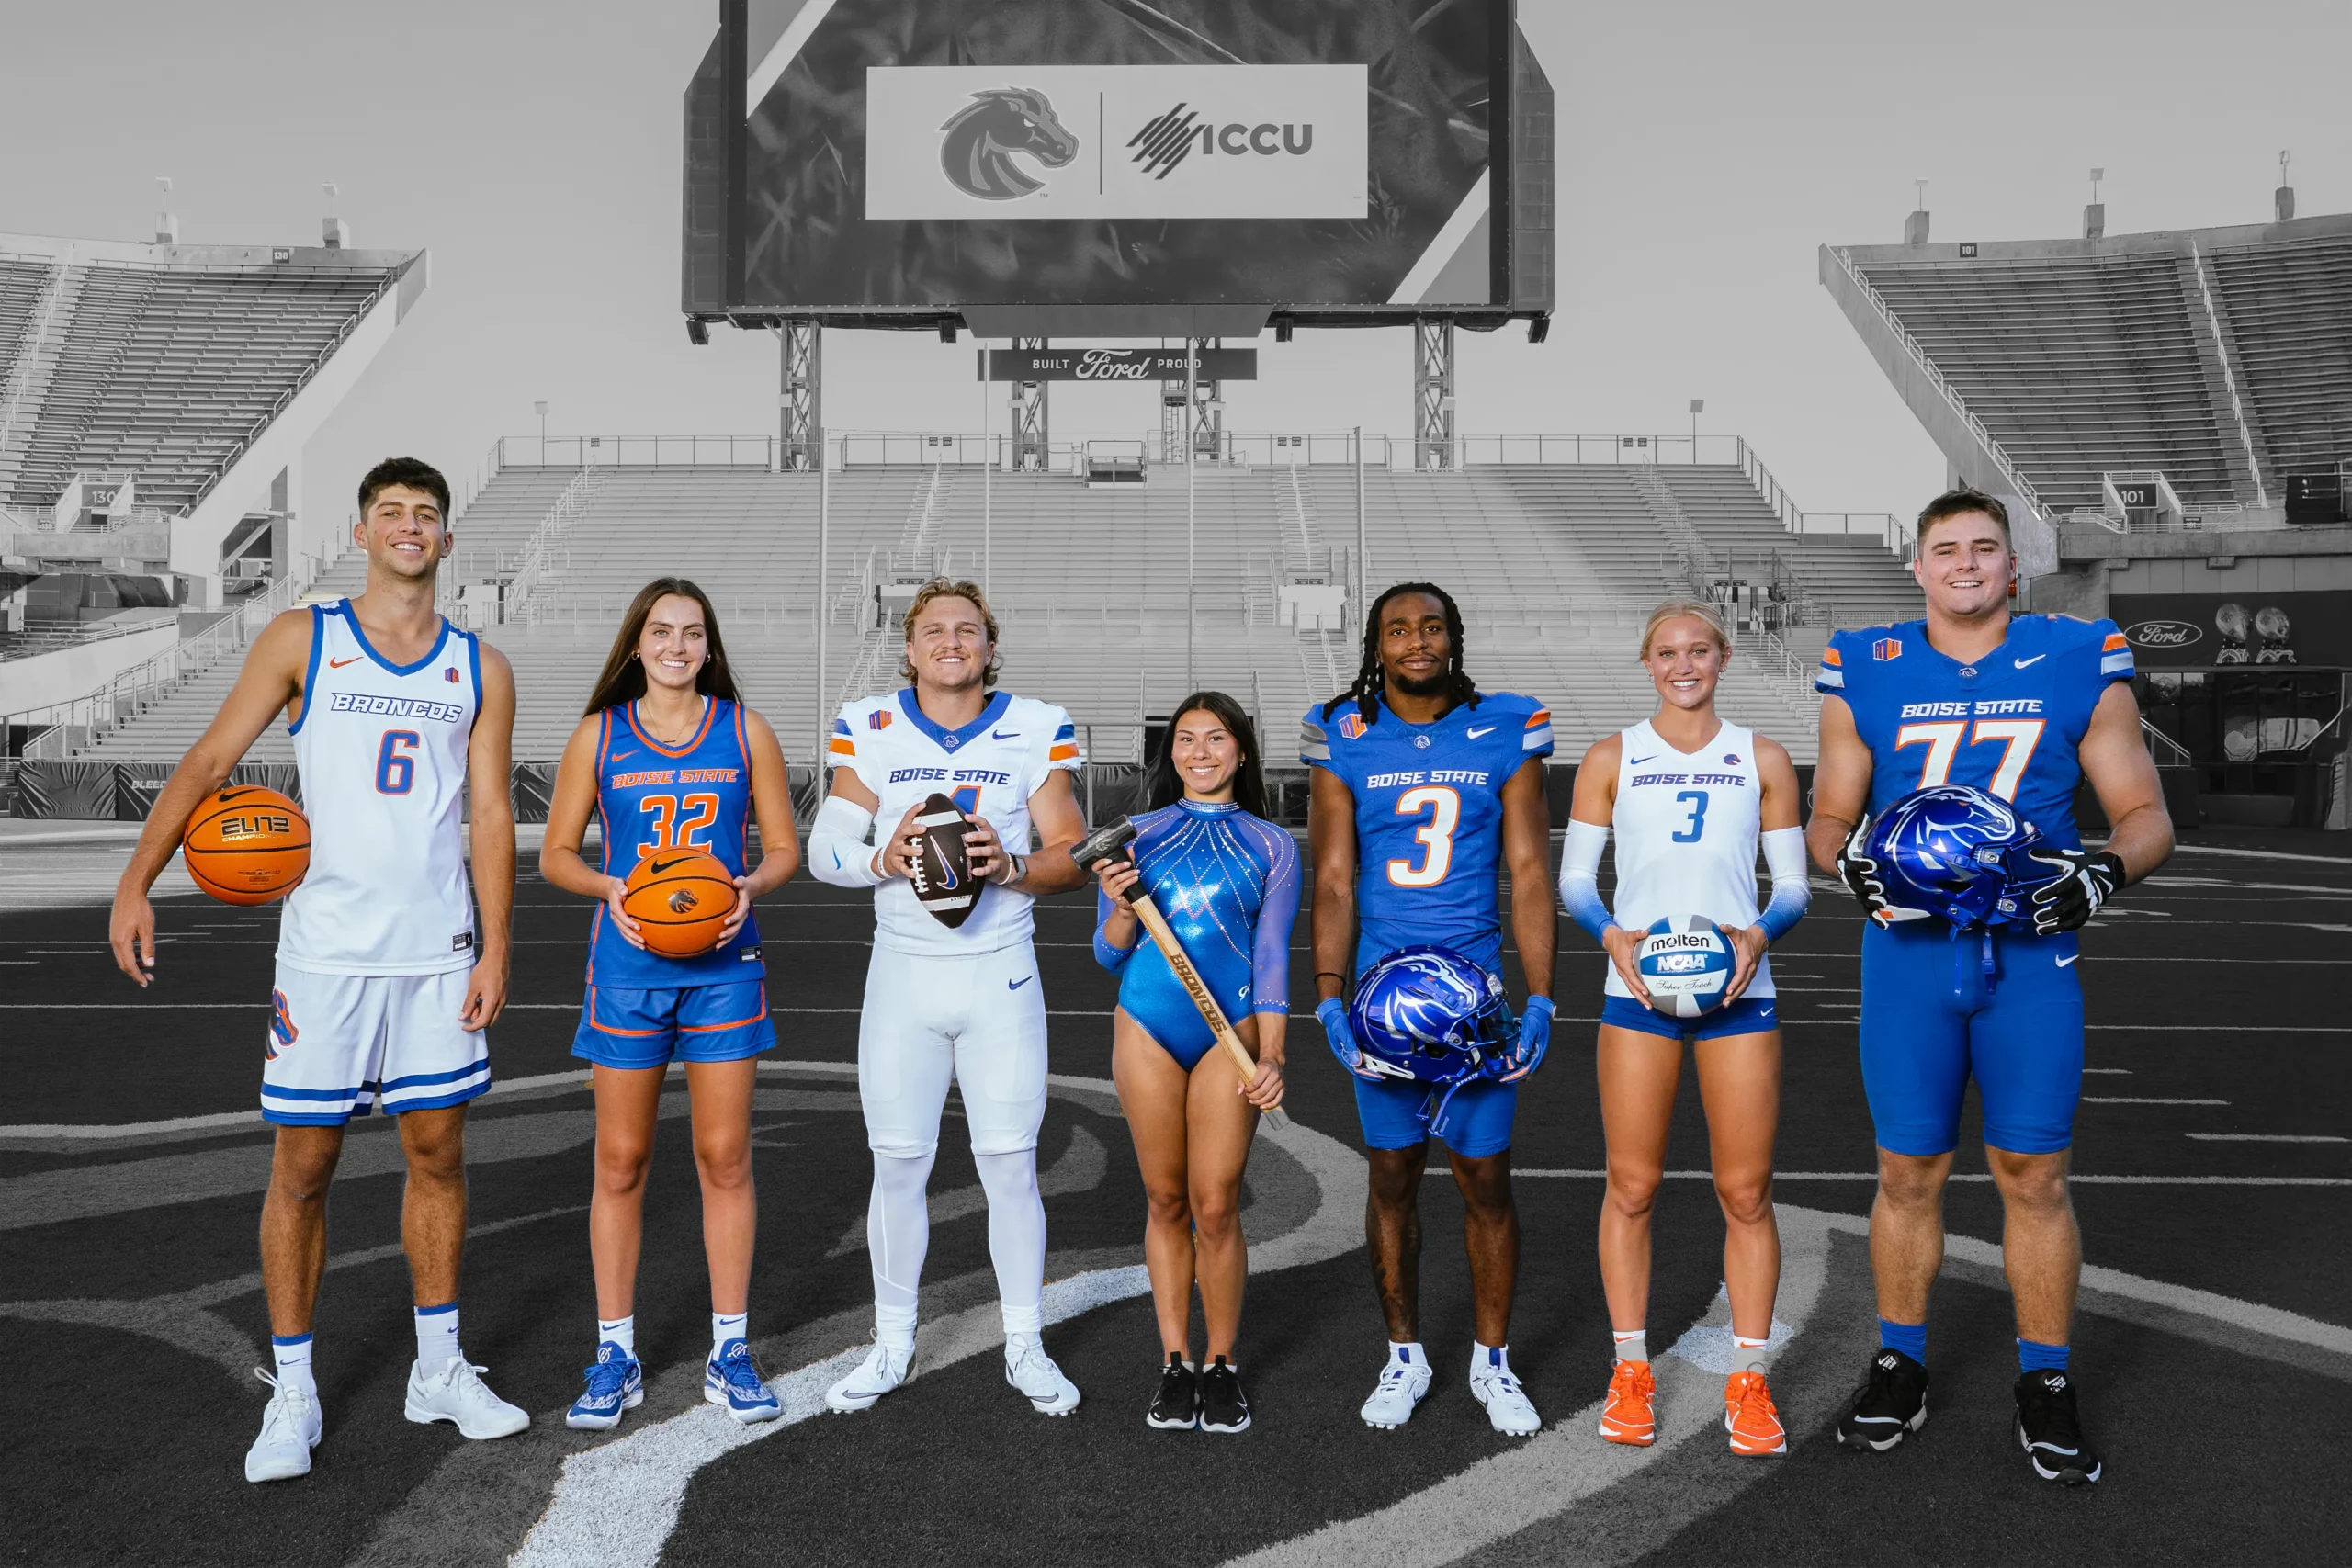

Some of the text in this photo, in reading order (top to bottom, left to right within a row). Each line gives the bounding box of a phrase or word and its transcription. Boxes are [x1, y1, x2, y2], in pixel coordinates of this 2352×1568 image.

[1203, 123, 1312, 155] ICCU
[273, 251, 288, 260] 130
[1962, 245, 1975, 254] 101
[1033, 359, 1069, 369] BUILT
[1075, 349, 1152, 379] Ford
[92, 491, 116, 504] 130
[2121, 490, 2144, 503] 101
[2138, 624, 2188, 643] Ford
[331, 693, 463, 723] BRONCOS
[1900, 699, 2044, 718] BOISE STATE
[375, 729, 421, 795] 6
[1894, 718, 2047, 805] 77
[612, 768, 740, 789] BOISE STATE
[888, 767, 1011, 785] BOISE STATE
[1367, 770, 1489, 789] BOISE STATE
[1631, 773, 1746, 787] BOISE STATE
[221, 816, 290, 836] ELITE
[637, 792, 720, 859] 32
[1672, 791, 1709, 843] 3
[1386, 784, 1462, 888] 3
[1651, 934, 1710, 952] molten
[1657, 953, 1706, 971] NCAA
[1170, 953, 1227, 1032] BRONCOS
[1656, 978, 1713, 992] Super Touch
